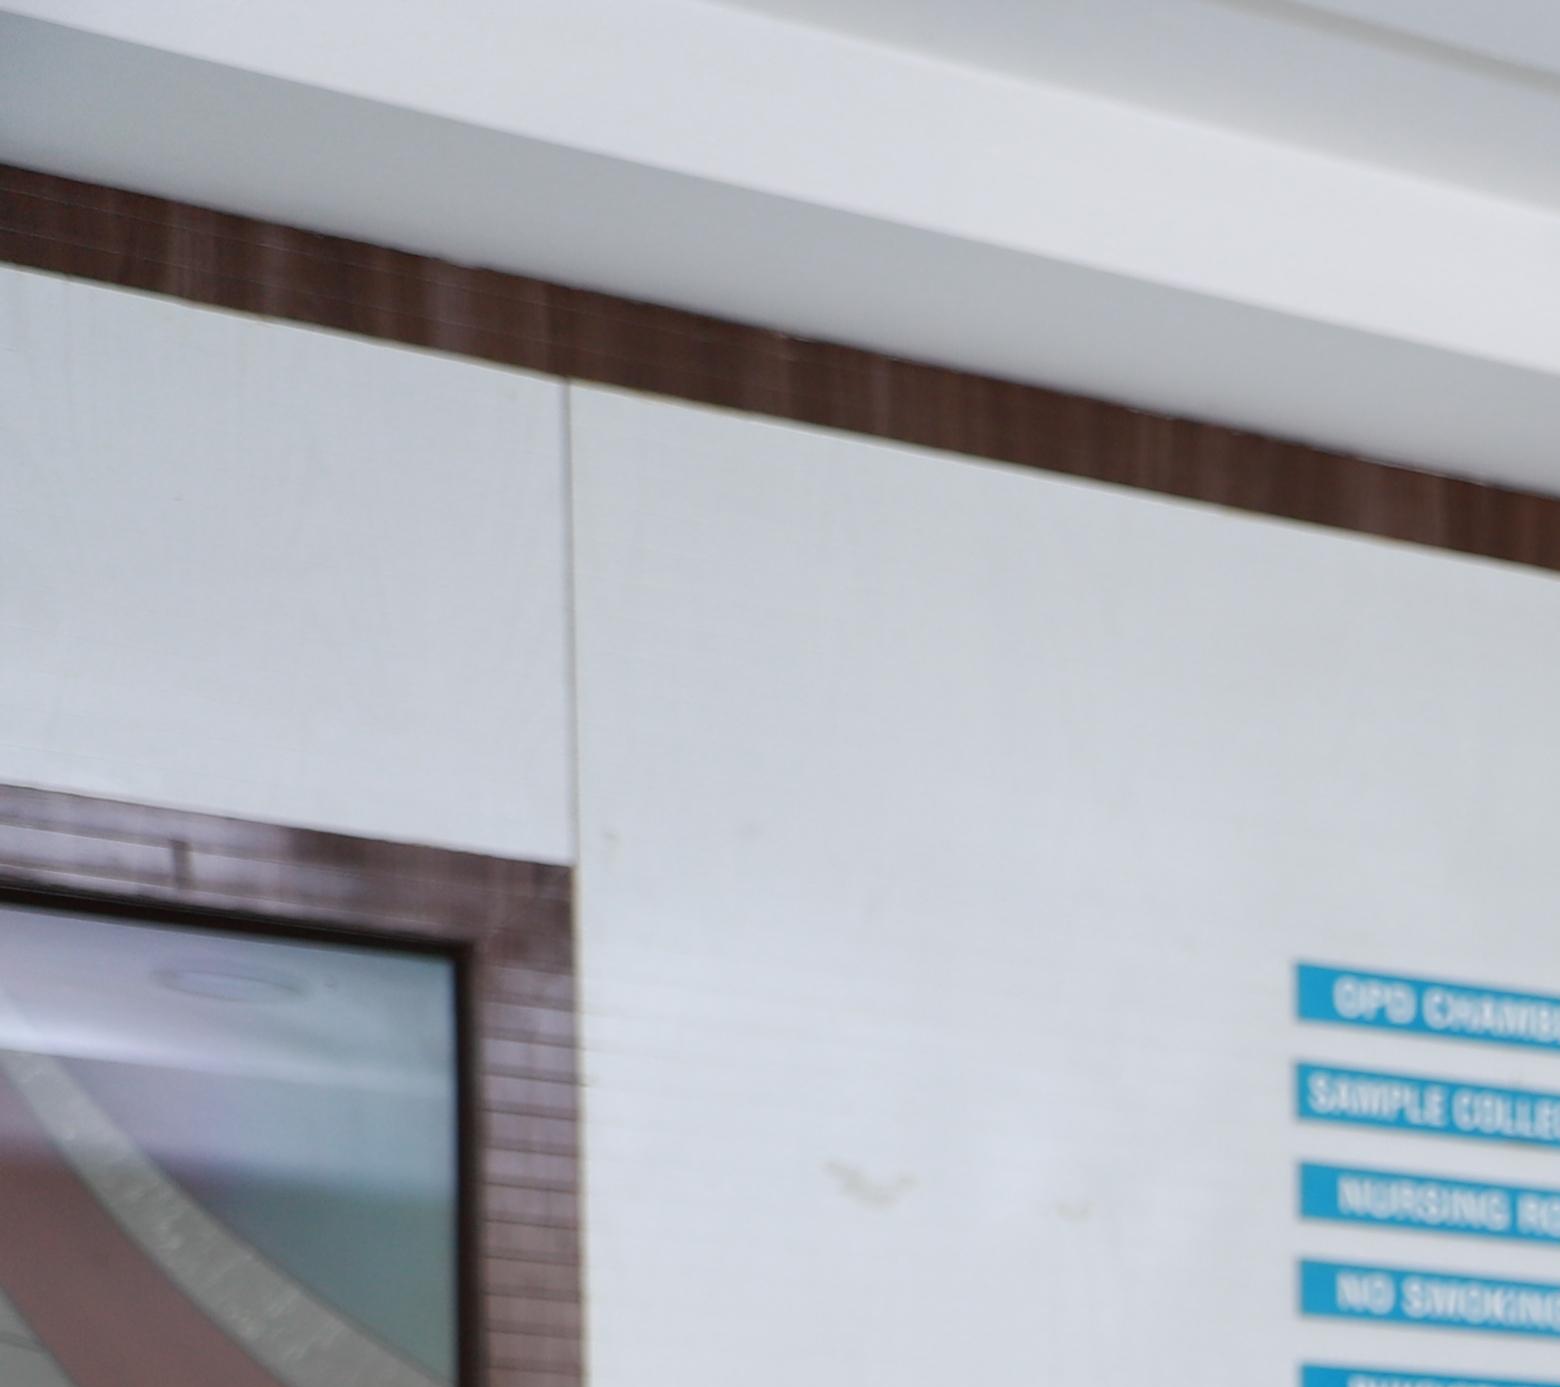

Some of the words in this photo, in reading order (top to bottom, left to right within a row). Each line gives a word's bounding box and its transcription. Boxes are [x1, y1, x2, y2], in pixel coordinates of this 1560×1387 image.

[1333, 974, 1416, 1024] OPD
[1307, 1071, 1446, 1128] SAMPLE
[1337, 1175, 1510, 1233] NURSING
[1335, 1271, 1395, 1315] NO
